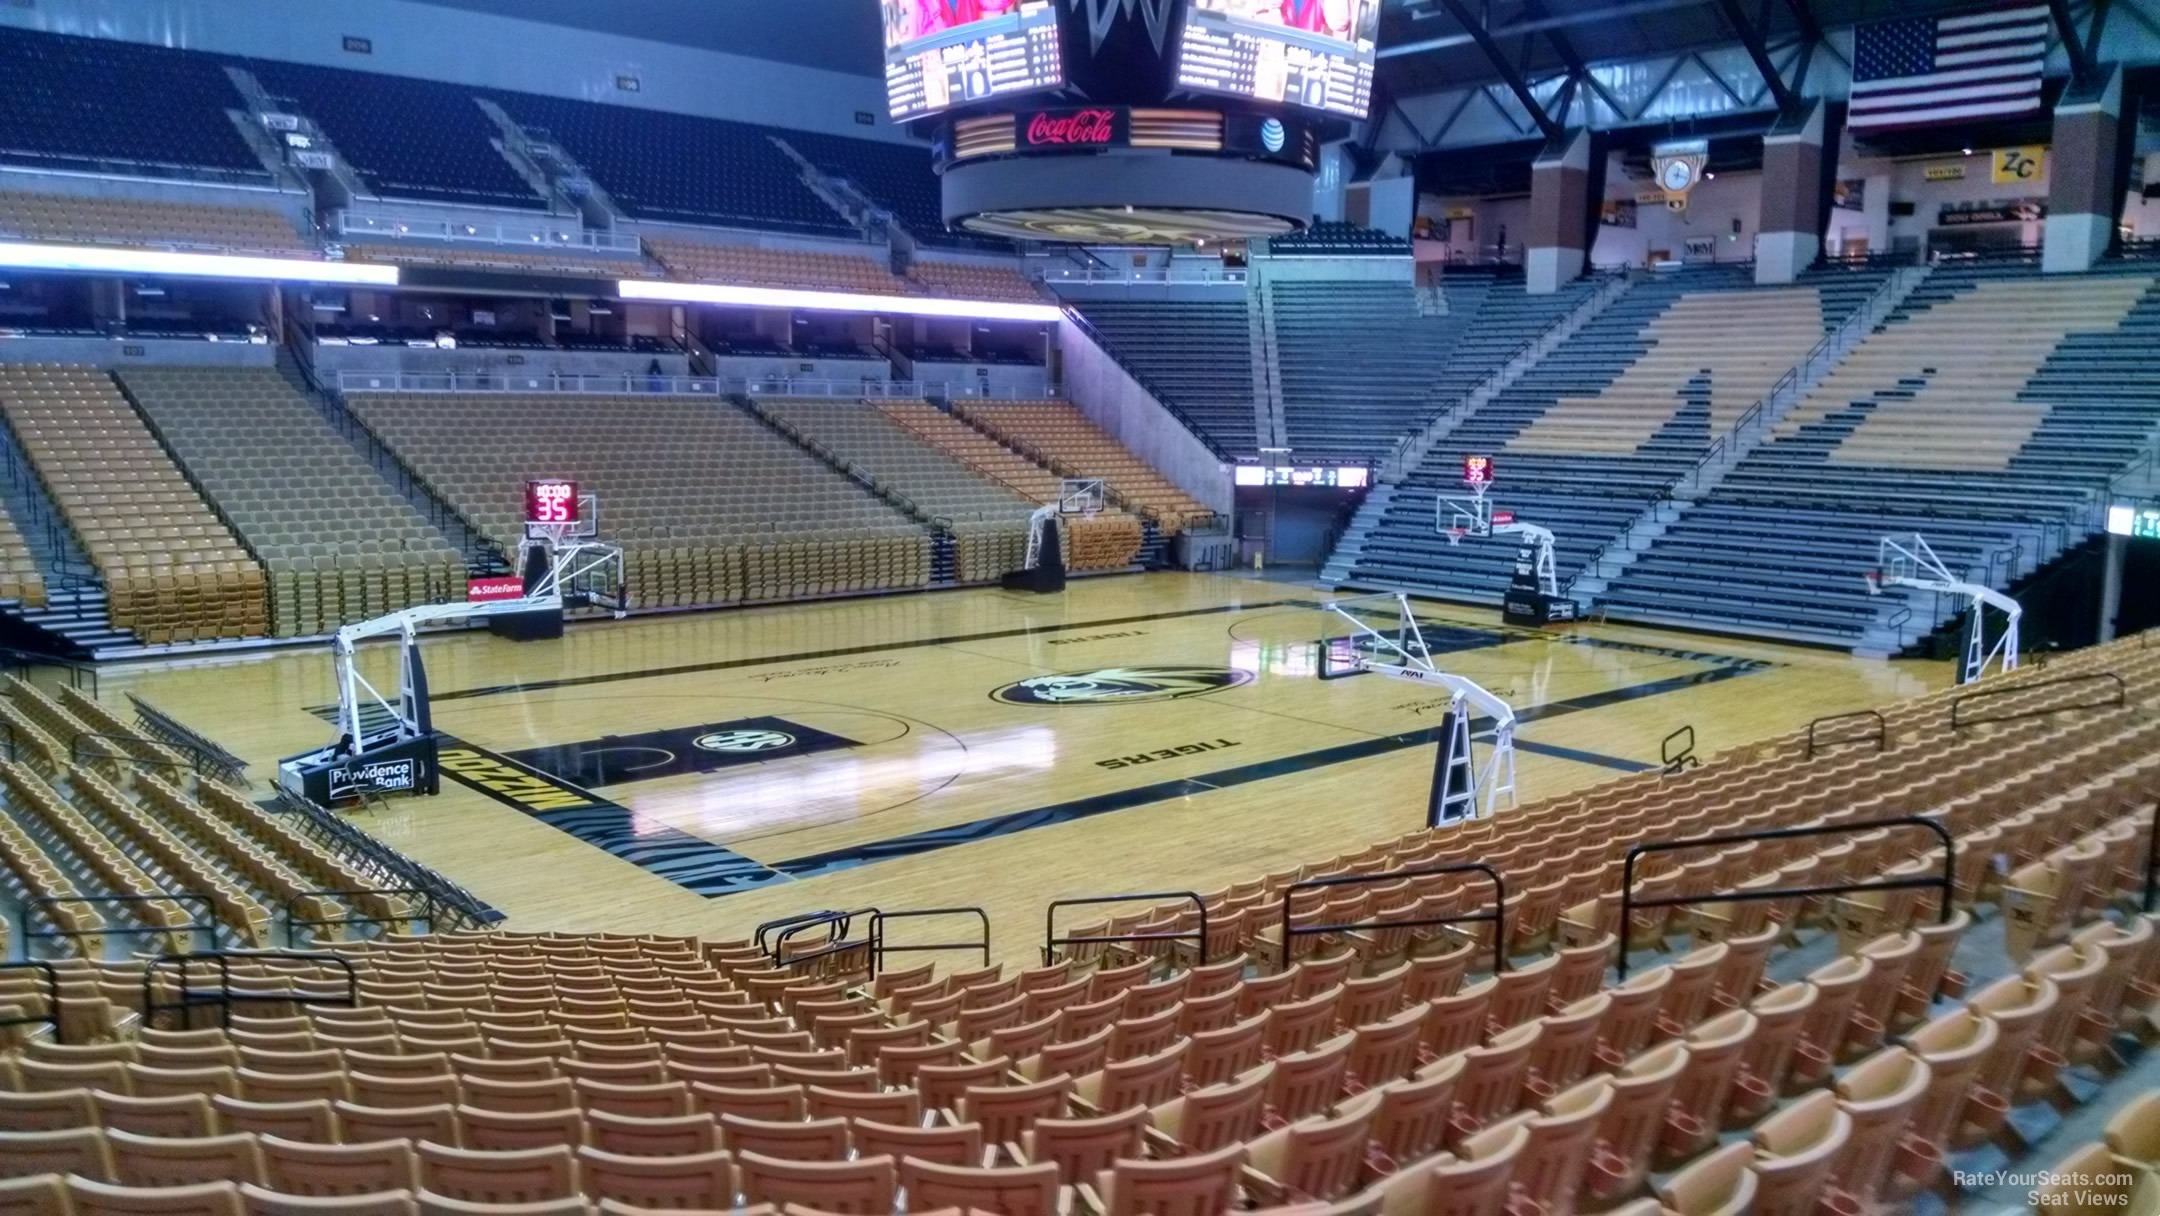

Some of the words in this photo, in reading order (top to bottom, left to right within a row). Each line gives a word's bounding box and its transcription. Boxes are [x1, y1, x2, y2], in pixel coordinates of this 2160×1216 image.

[1027, 109, 1116, 145] Coca-Cola
[1468, 466, 1485, 481] 35
[536, 484, 571, 499] 10:00
[538, 497, 567, 521] 35
[1046, 630, 1151, 646] TIGERS
[1094, 738, 1242, 771] TIGERS
[333, 763, 410, 784] Providence
[376, 773, 411, 789] Bank
